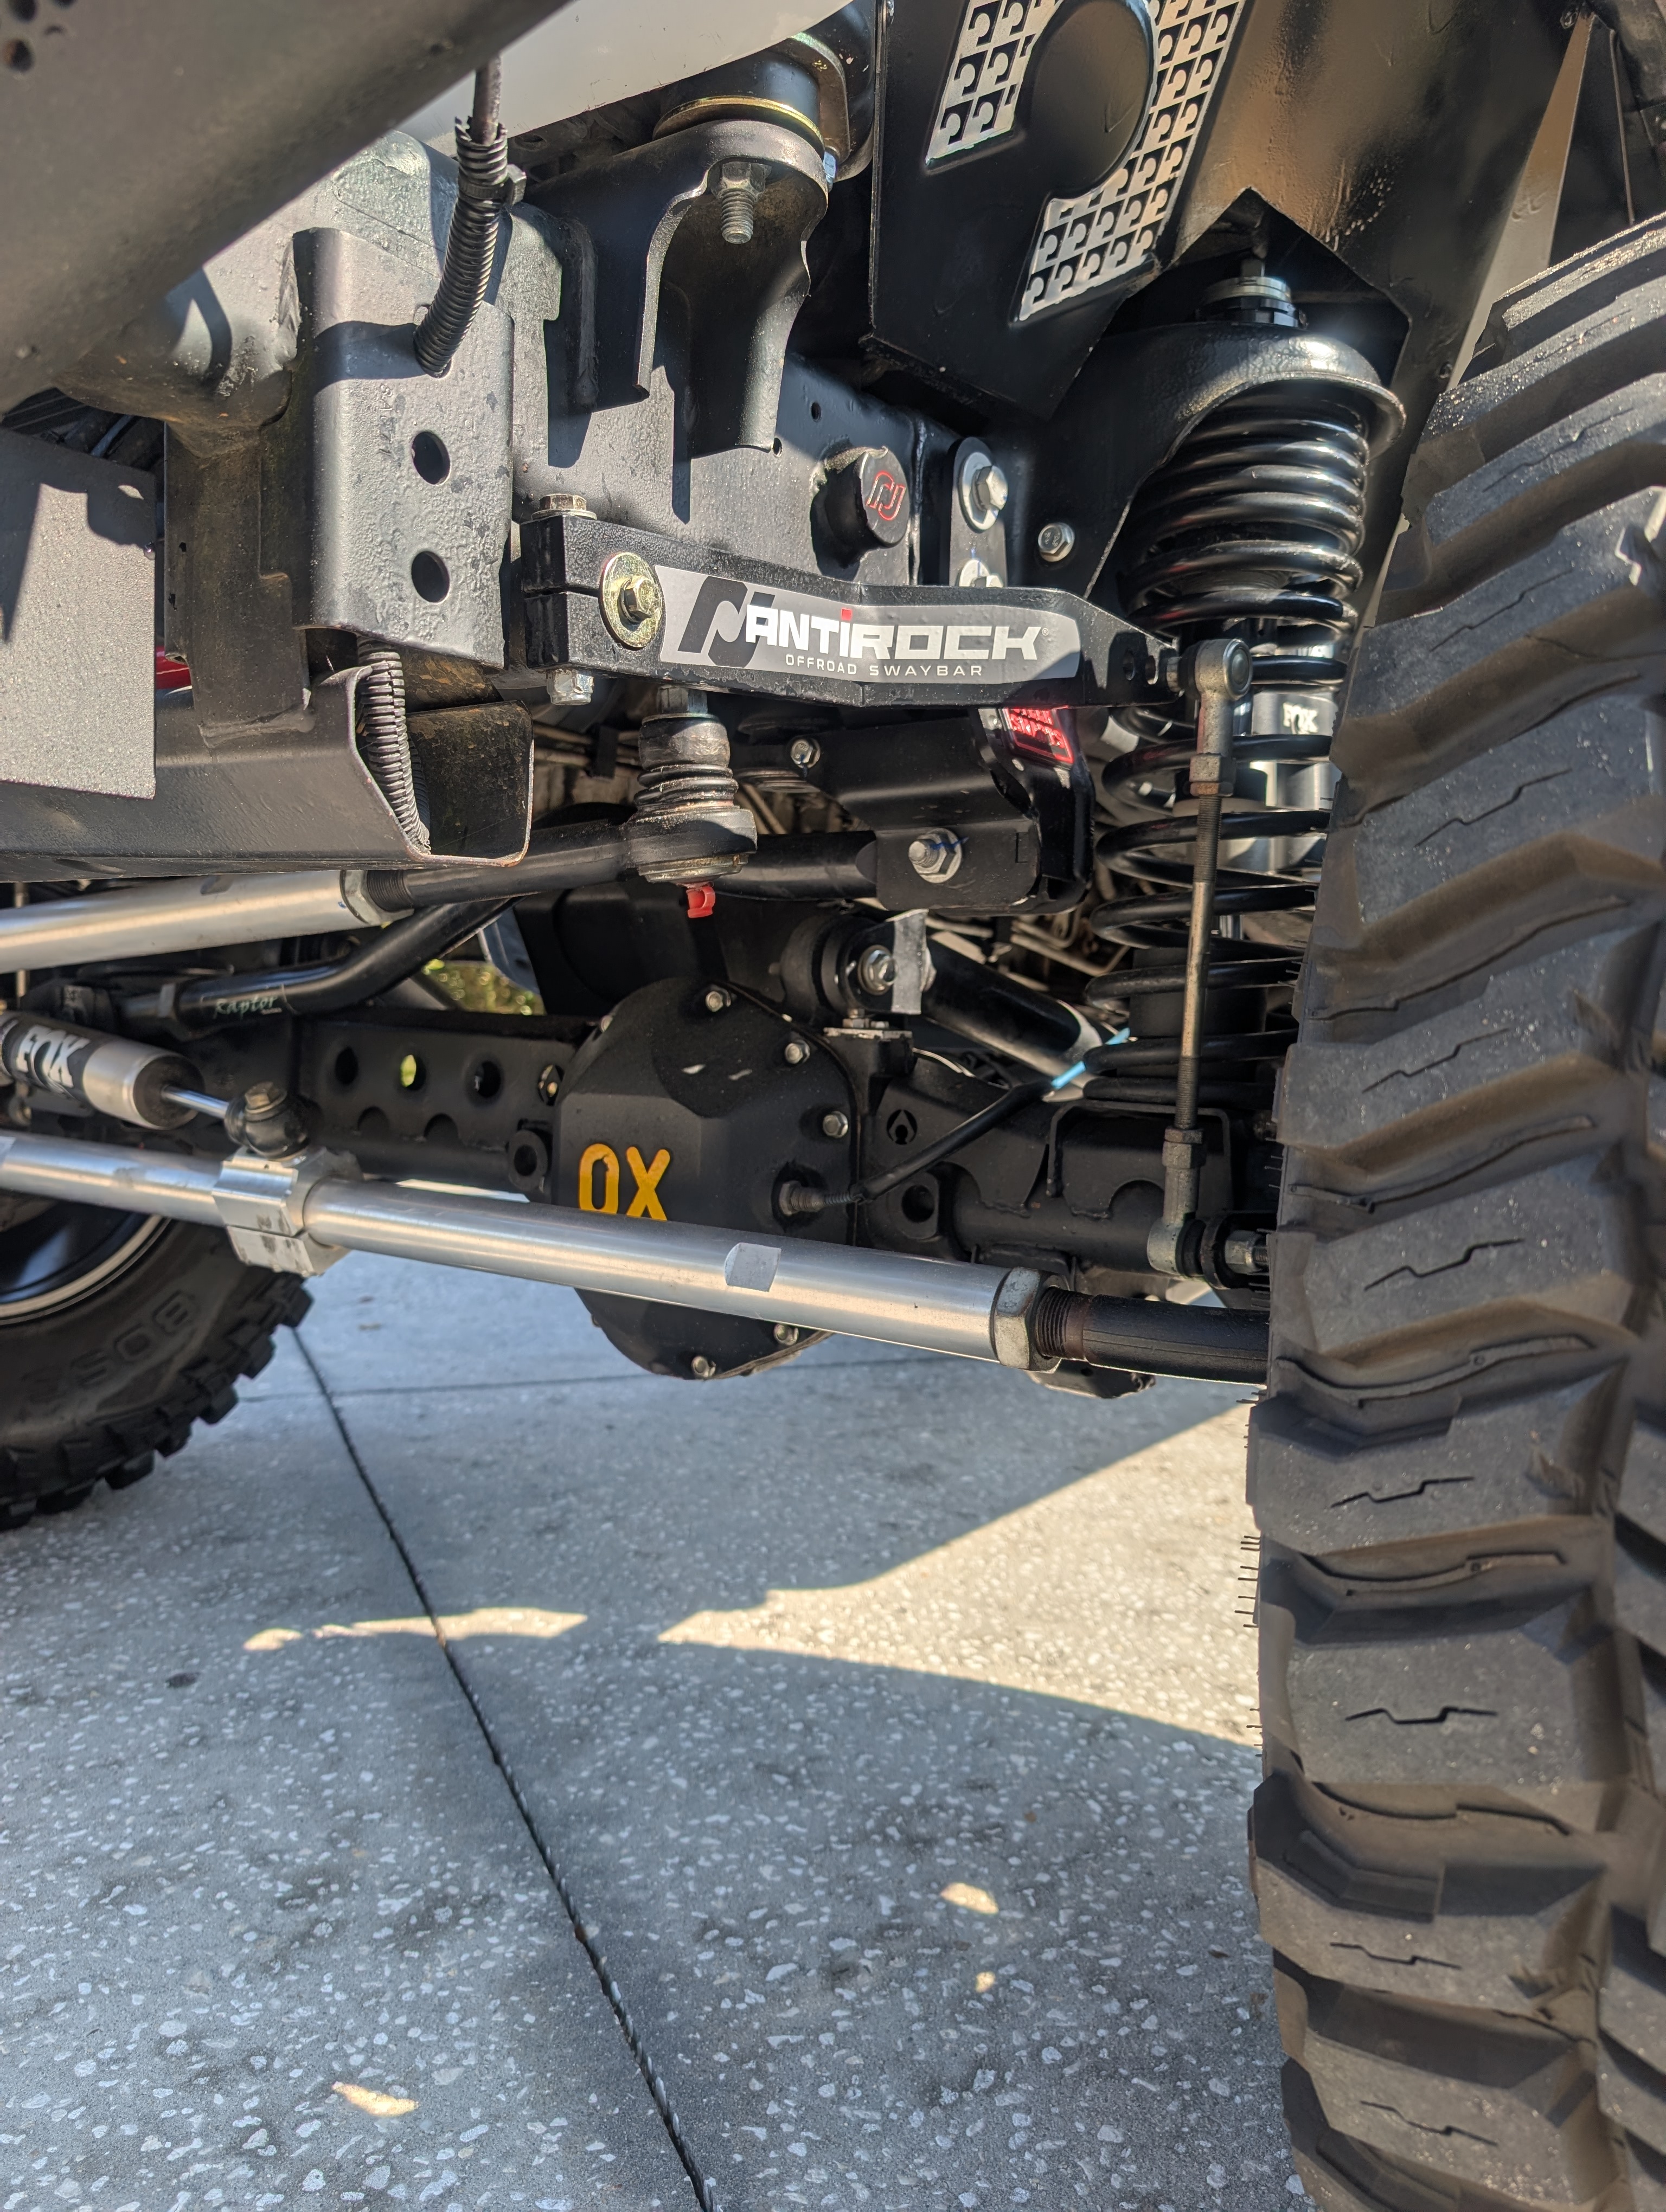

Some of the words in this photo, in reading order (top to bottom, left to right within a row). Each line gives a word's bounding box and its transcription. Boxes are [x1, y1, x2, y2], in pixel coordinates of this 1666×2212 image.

[785, 654, 857, 675] OFFROAD
[869, 665, 983, 677] SWAYBAR
[1283, 702, 1319, 735] FOX
[213, 994, 278, 1023] Raptor
[17, 1024, 91, 1099] FOX
[579, 1143, 670, 1221] OX
